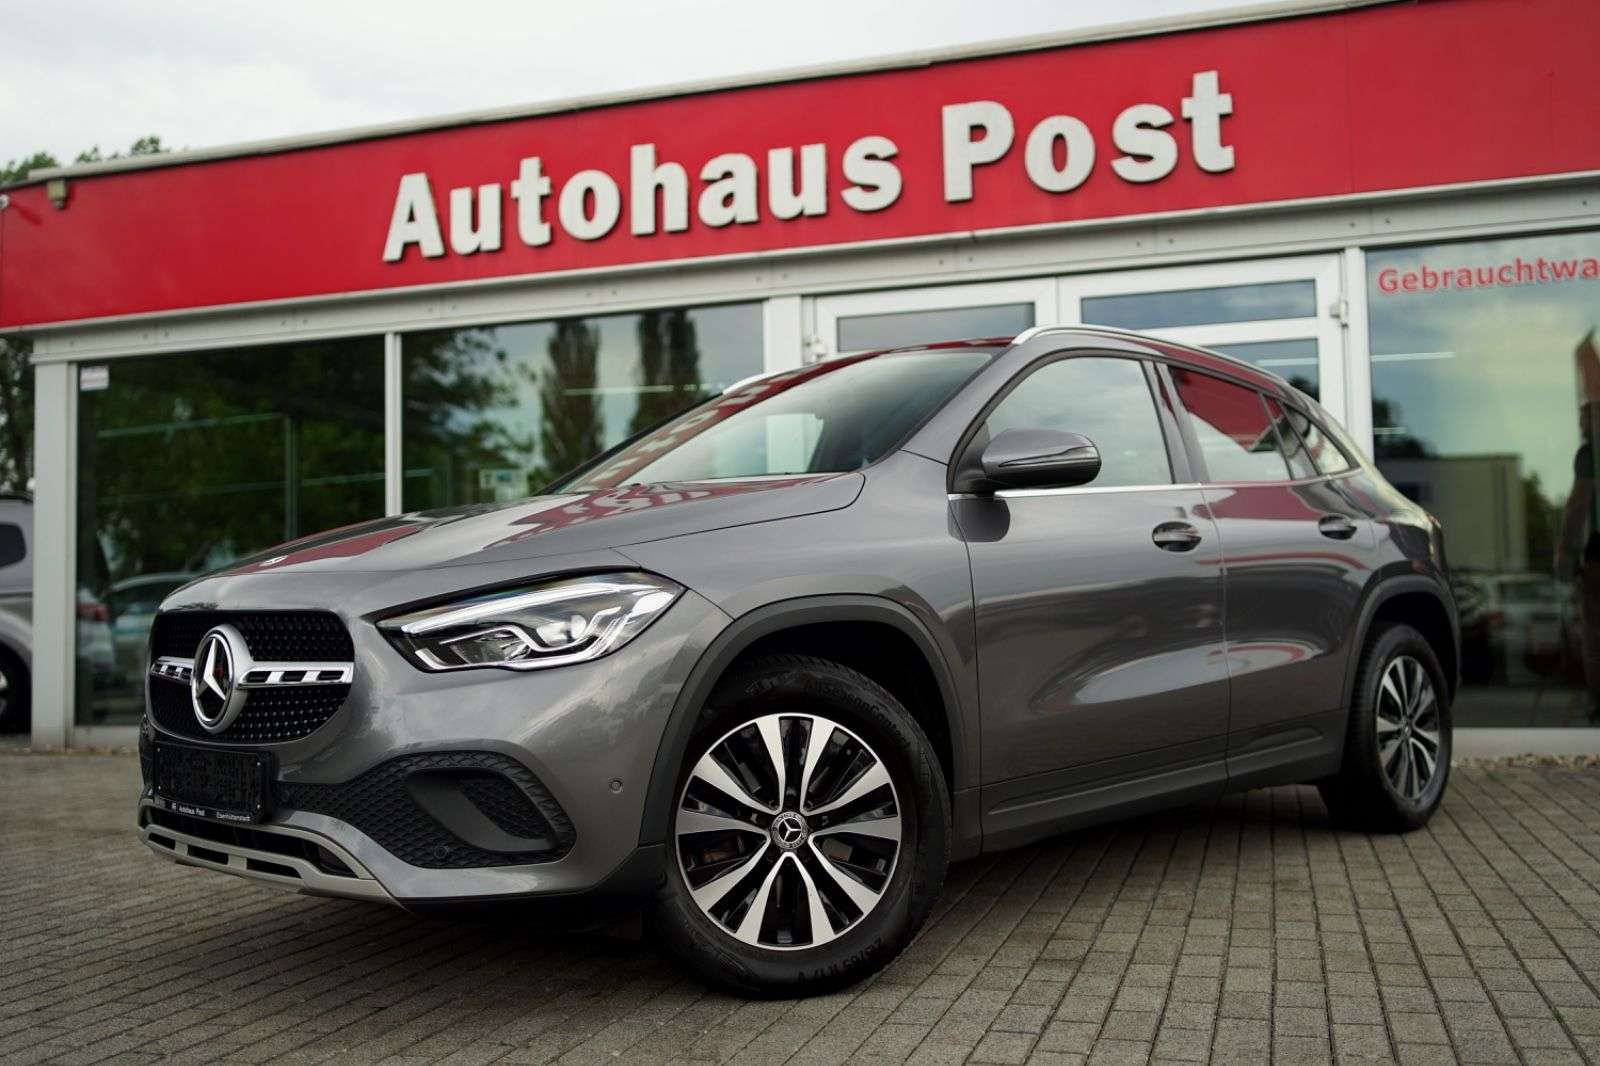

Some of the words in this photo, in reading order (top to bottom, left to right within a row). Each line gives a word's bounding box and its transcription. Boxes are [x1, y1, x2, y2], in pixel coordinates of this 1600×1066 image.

[384, 137, 901, 260] Autohaus
[943, 71, 1234, 201] Post
[1377, 255, 1600, 295] Gebrauchtwa
